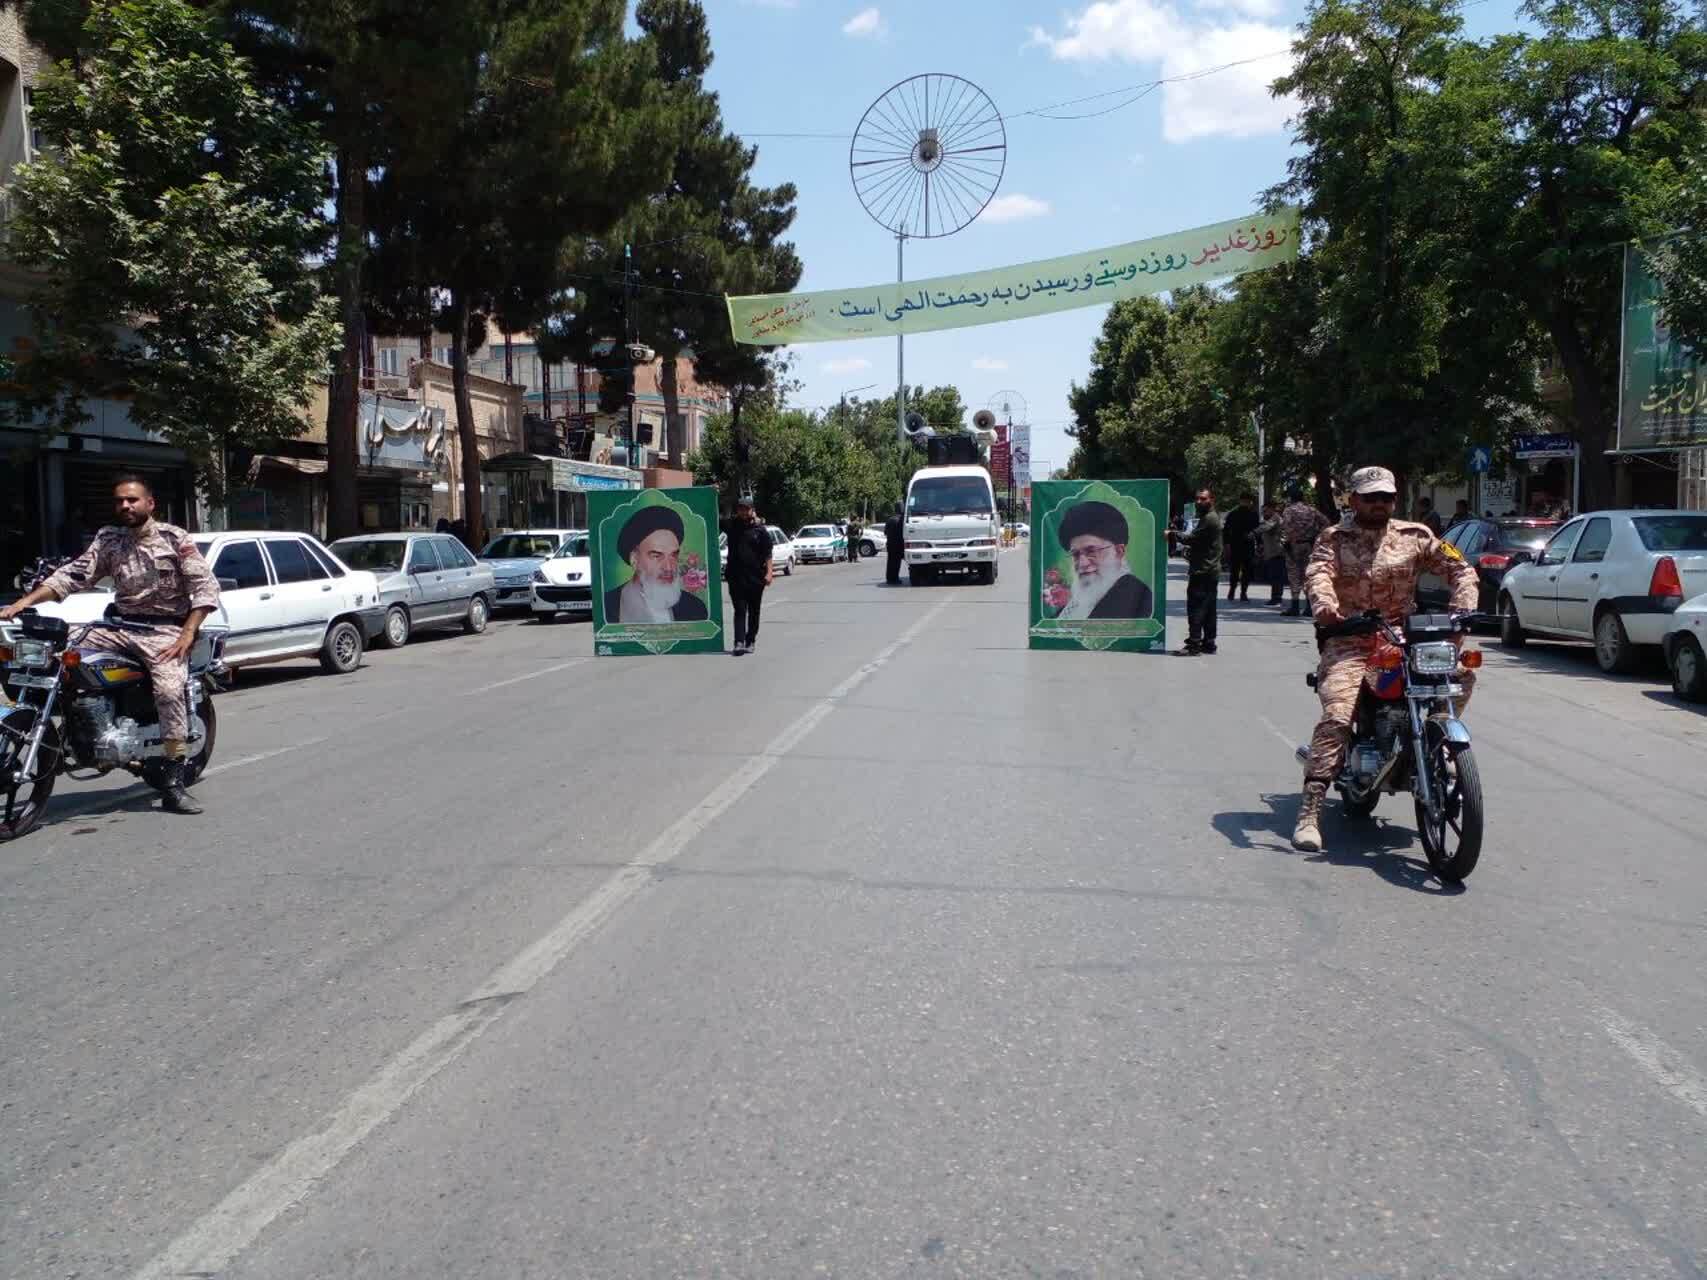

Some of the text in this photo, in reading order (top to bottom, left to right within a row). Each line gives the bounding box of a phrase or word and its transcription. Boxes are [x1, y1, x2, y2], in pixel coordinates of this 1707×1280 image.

[1190, 227, 1250, 266] غدیر
[1245, 223, 1288, 253] روز
[1151, 251, 1188, 275] روز
[929, 290, 989, 310] رحمت
[991, 284, 1012, 305] به
[1014, 275, 1079, 301] رسیدن
[885, 290, 930, 322] الهی
